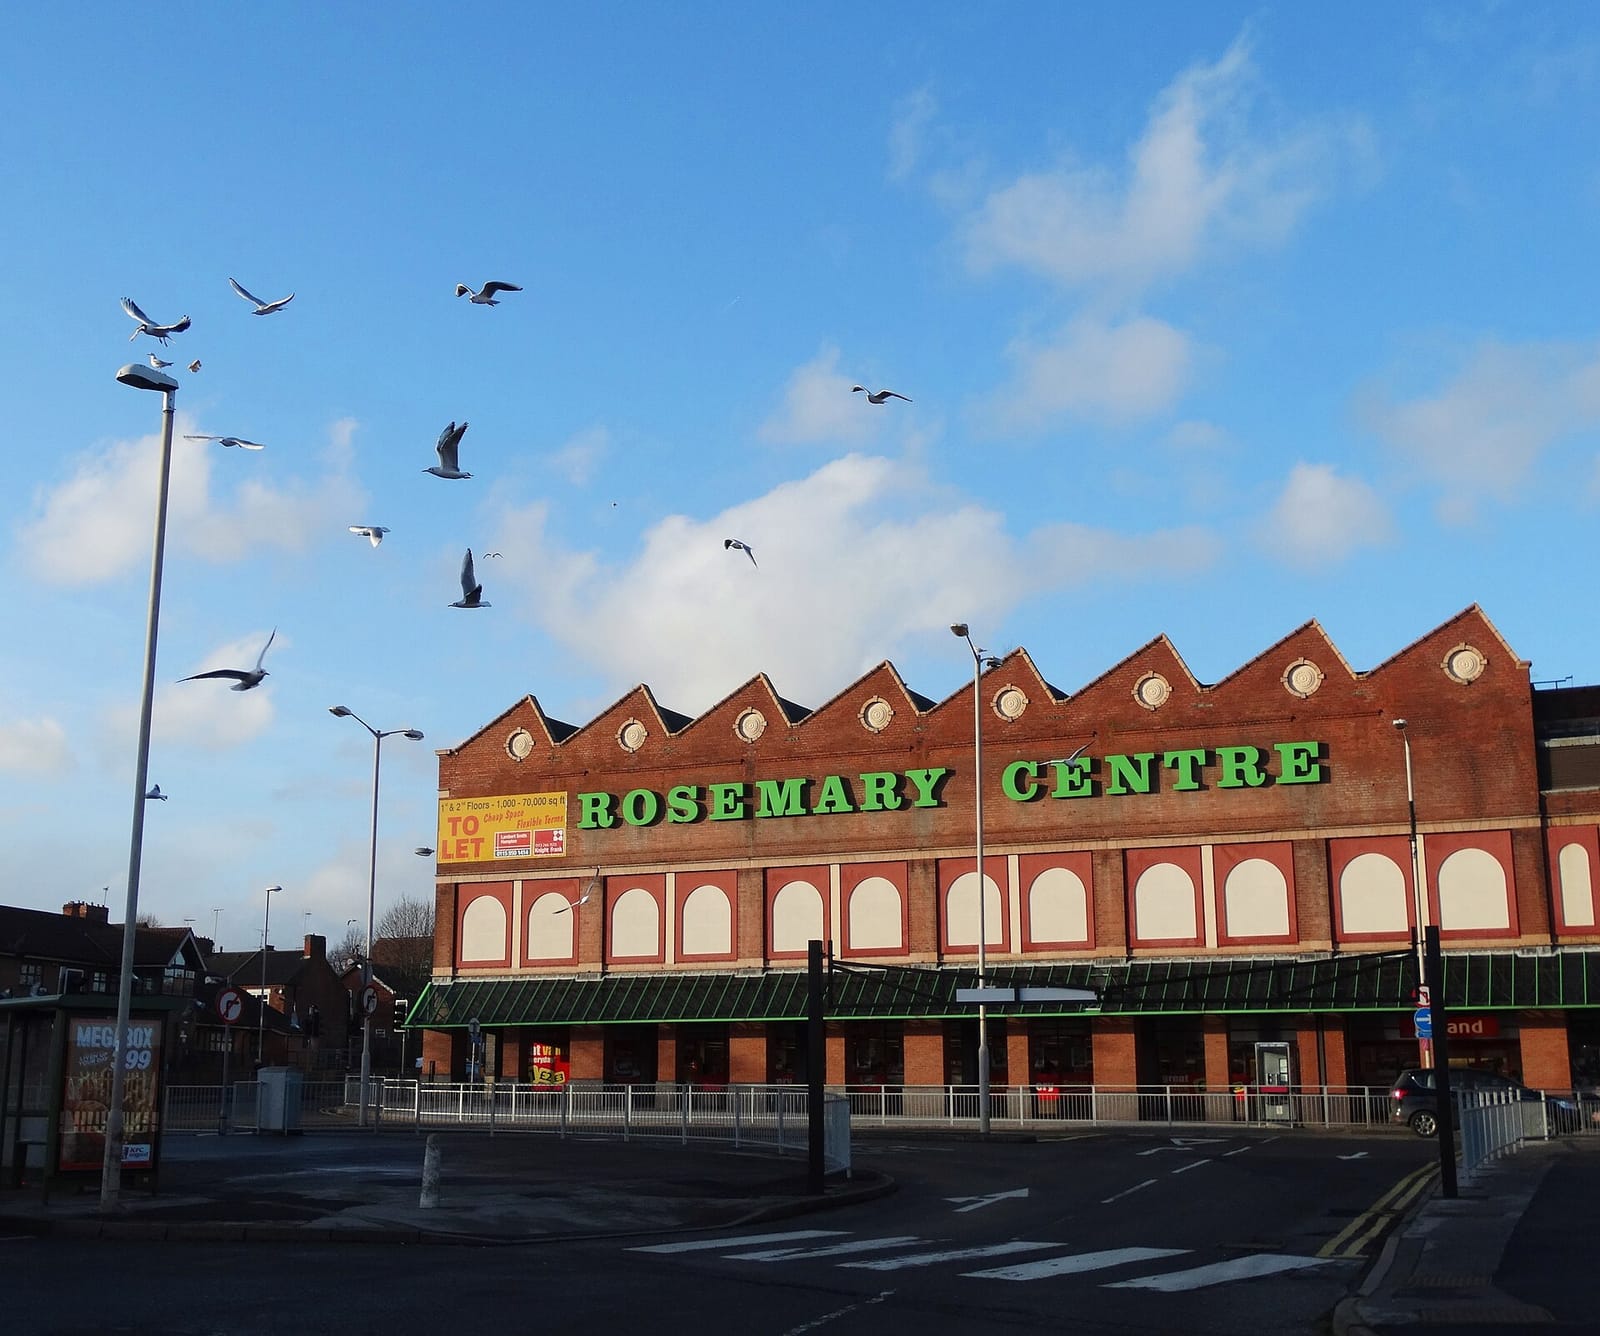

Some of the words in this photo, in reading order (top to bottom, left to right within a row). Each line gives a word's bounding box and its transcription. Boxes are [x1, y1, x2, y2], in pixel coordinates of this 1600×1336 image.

[577, 767, 947, 829] ROSEMARY
[1002, 741, 1321, 801] CENTRE
[467, 801, 490, 811] Floors
[496, 798, 516, 809] 1,000
[522, 796, 547, 807] 70,000
[548, 798, 558, 807] sq
[559, 795, 565, 804] ft
[447, 815, 480, 837] TO
[441, 837, 485, 860] LET
